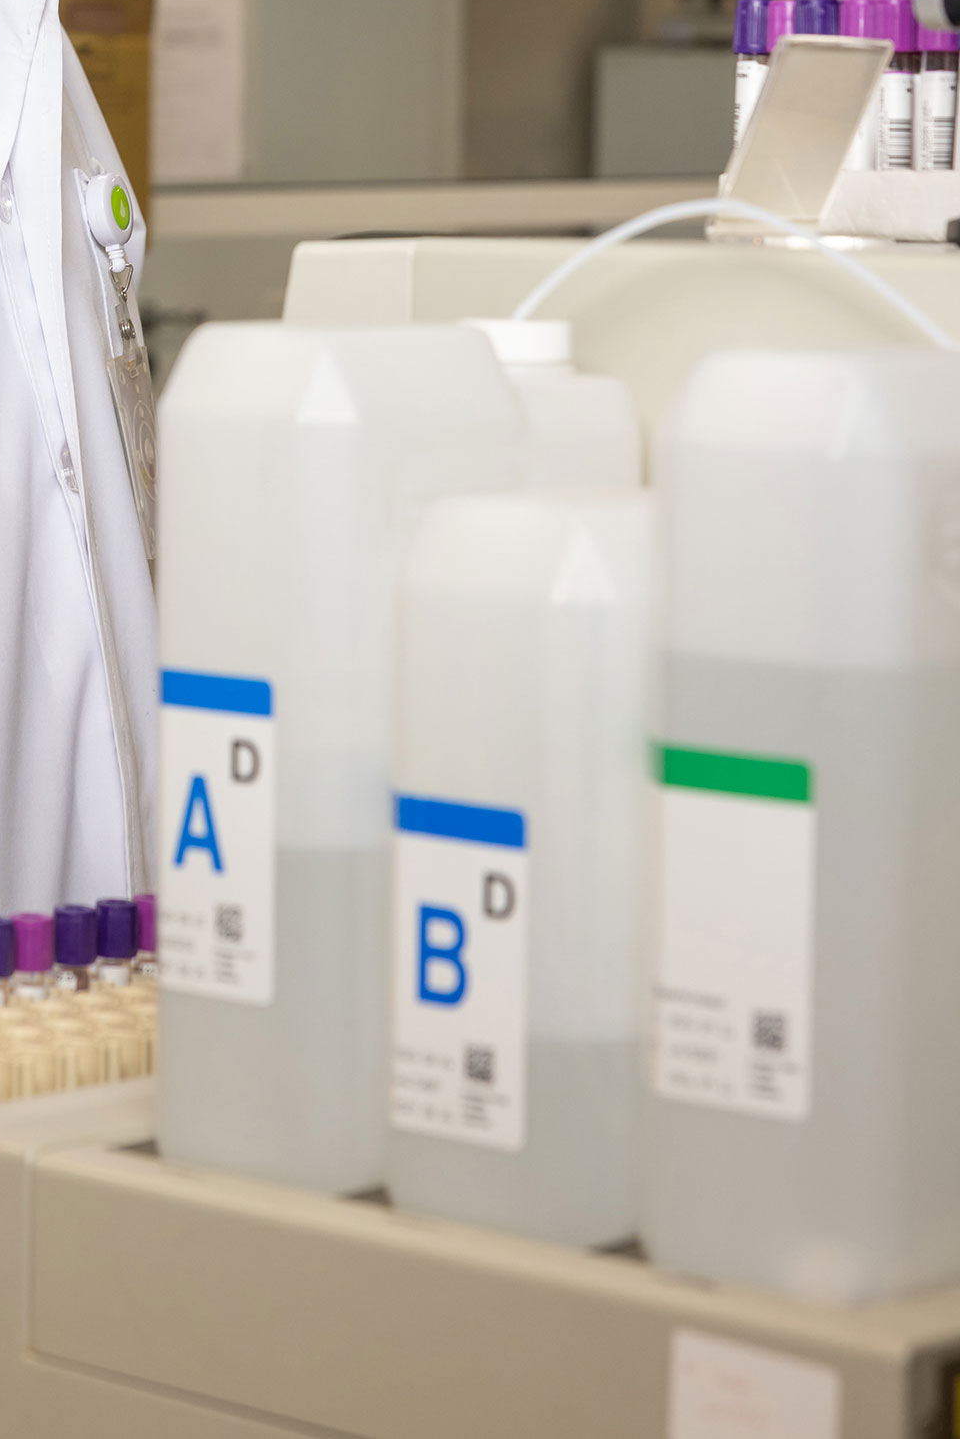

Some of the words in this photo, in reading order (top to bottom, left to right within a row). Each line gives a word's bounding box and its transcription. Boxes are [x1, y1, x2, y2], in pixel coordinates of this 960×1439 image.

[230, 737, 261, 785] D
[174, 774, 224, 875] A
[482, 870, 517, 922] D
[416, 900, 469, 1008] B
